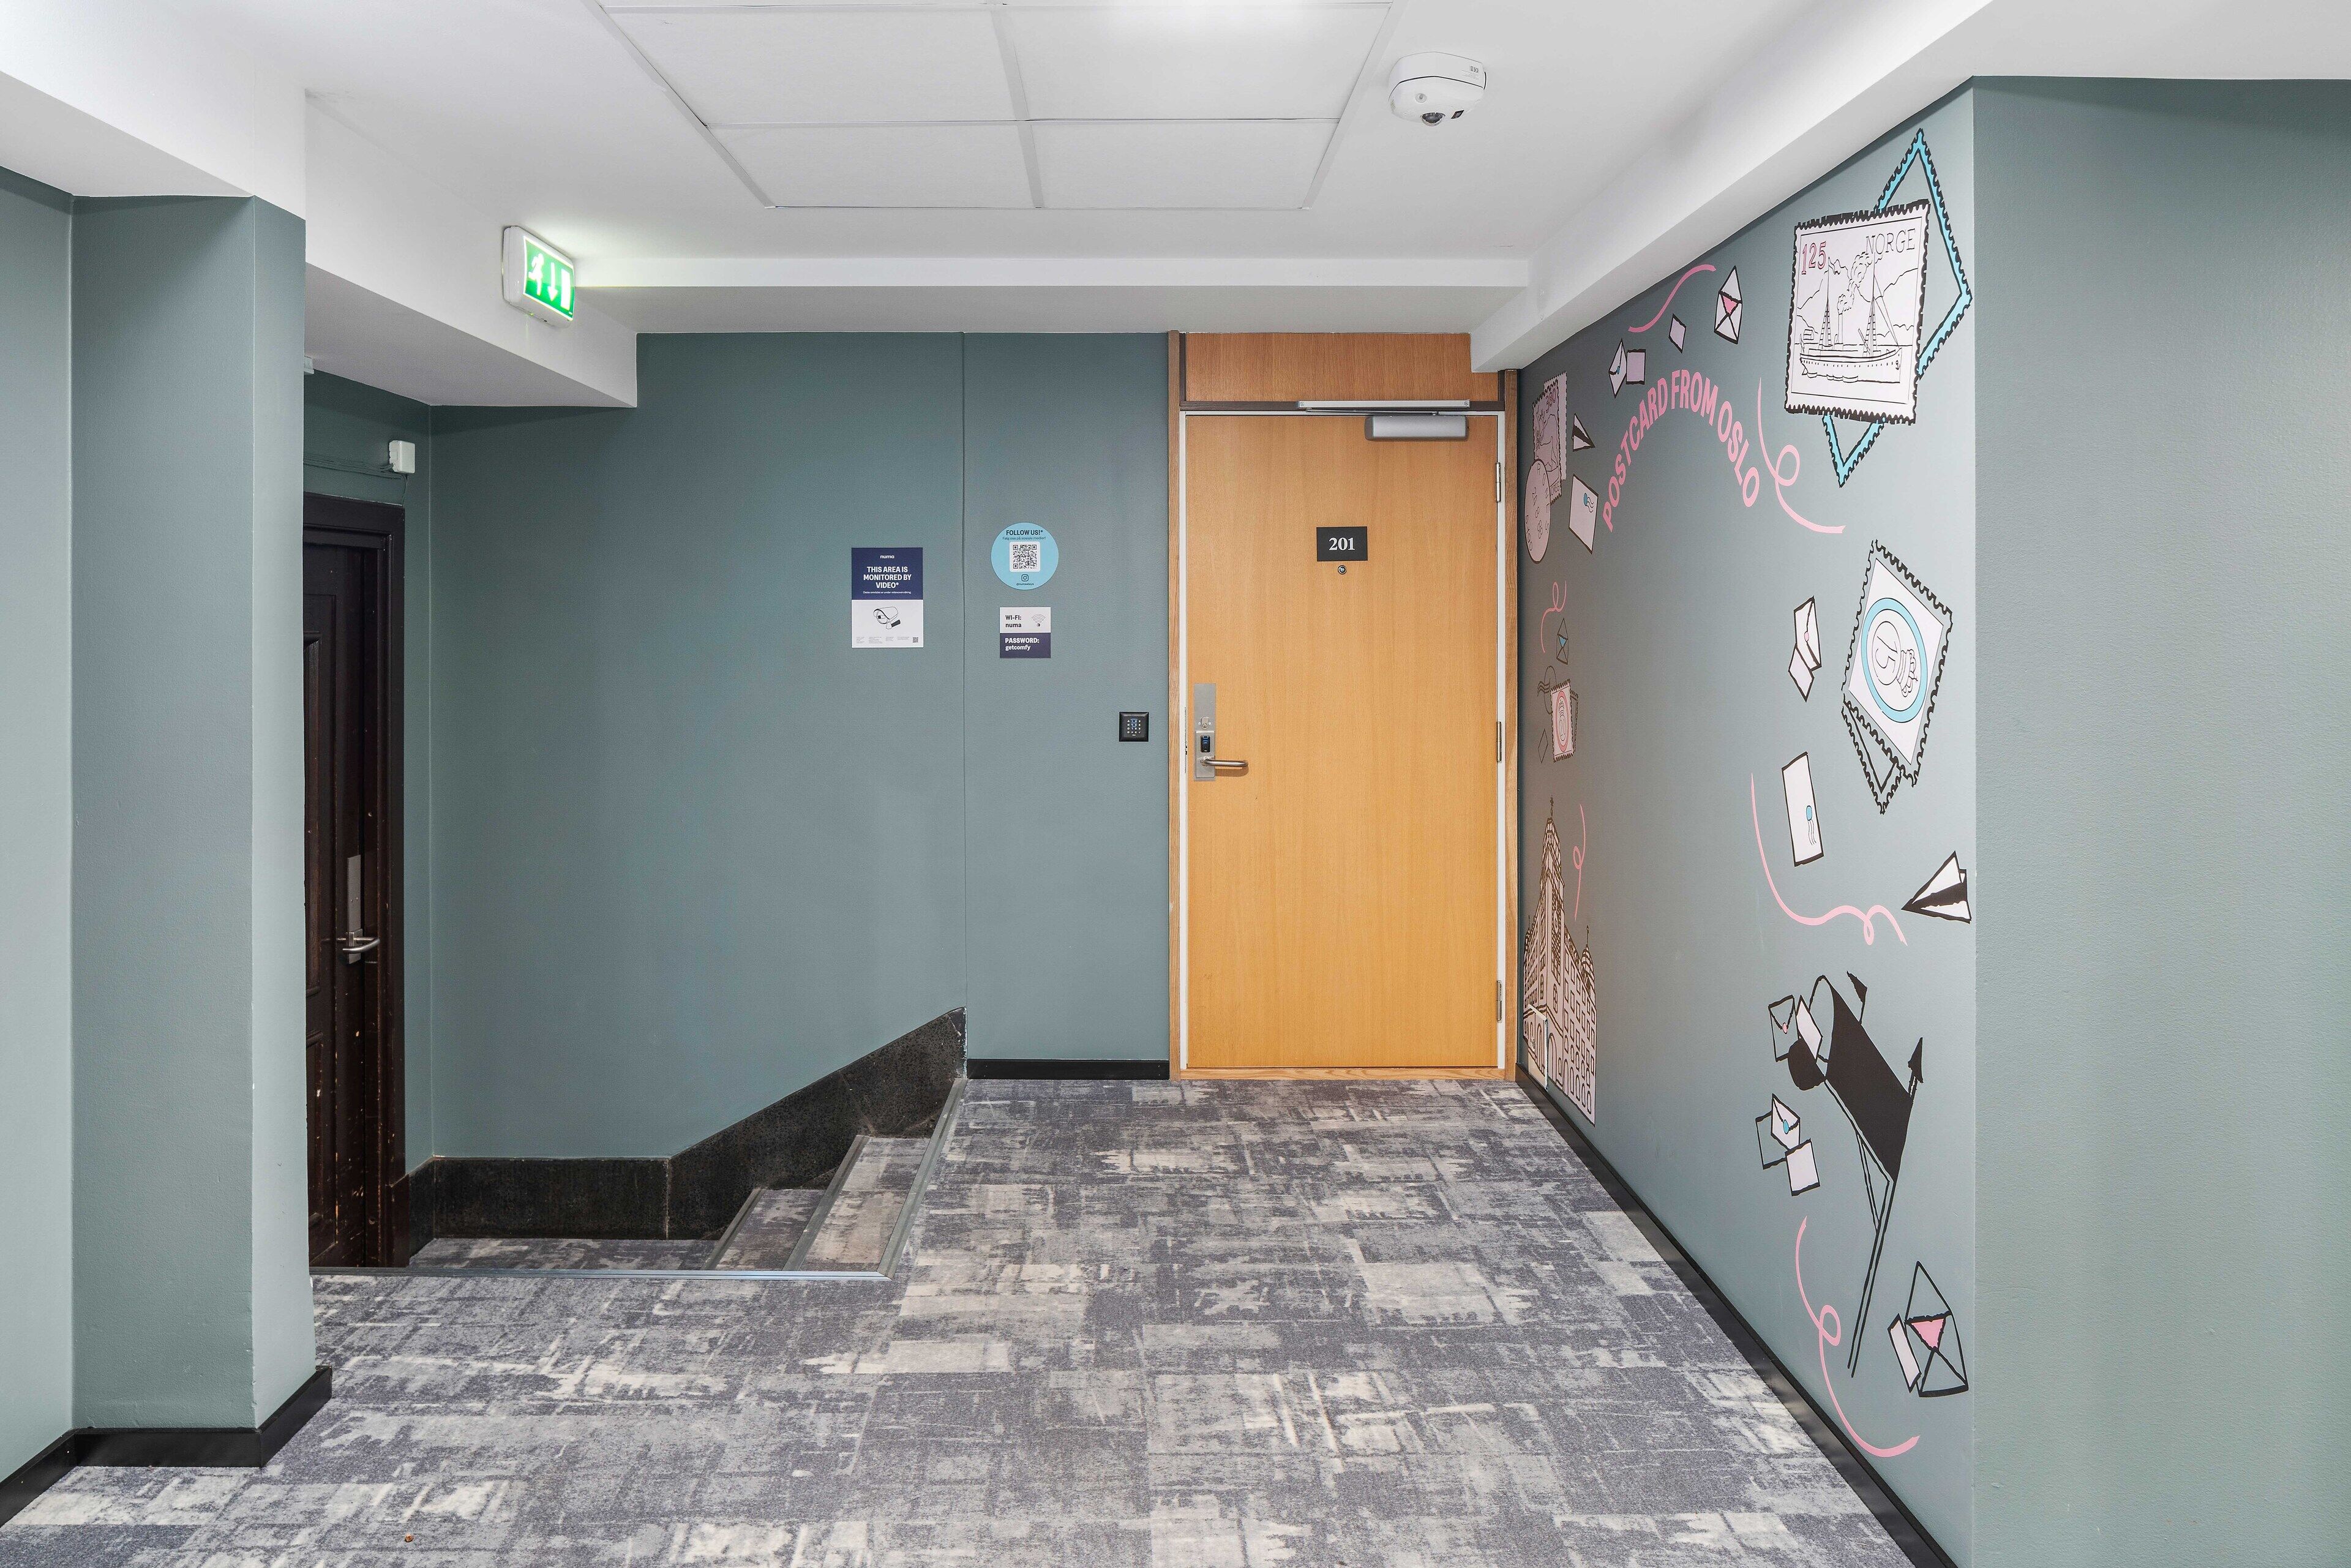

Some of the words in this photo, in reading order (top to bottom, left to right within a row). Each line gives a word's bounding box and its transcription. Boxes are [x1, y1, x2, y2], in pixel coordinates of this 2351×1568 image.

[1865, 228, 1916, 255] NORGE
[1801, 241, 1826, 275] 125
[1602, 378, 1668, 533] POSTCARD
[1671, 369, 1719, 426] FROM
[1717, 400, 1760, 508] OSLO
[1550, 481, 1560, 496] OREG
[1329, 537, 1355, 550] 201
